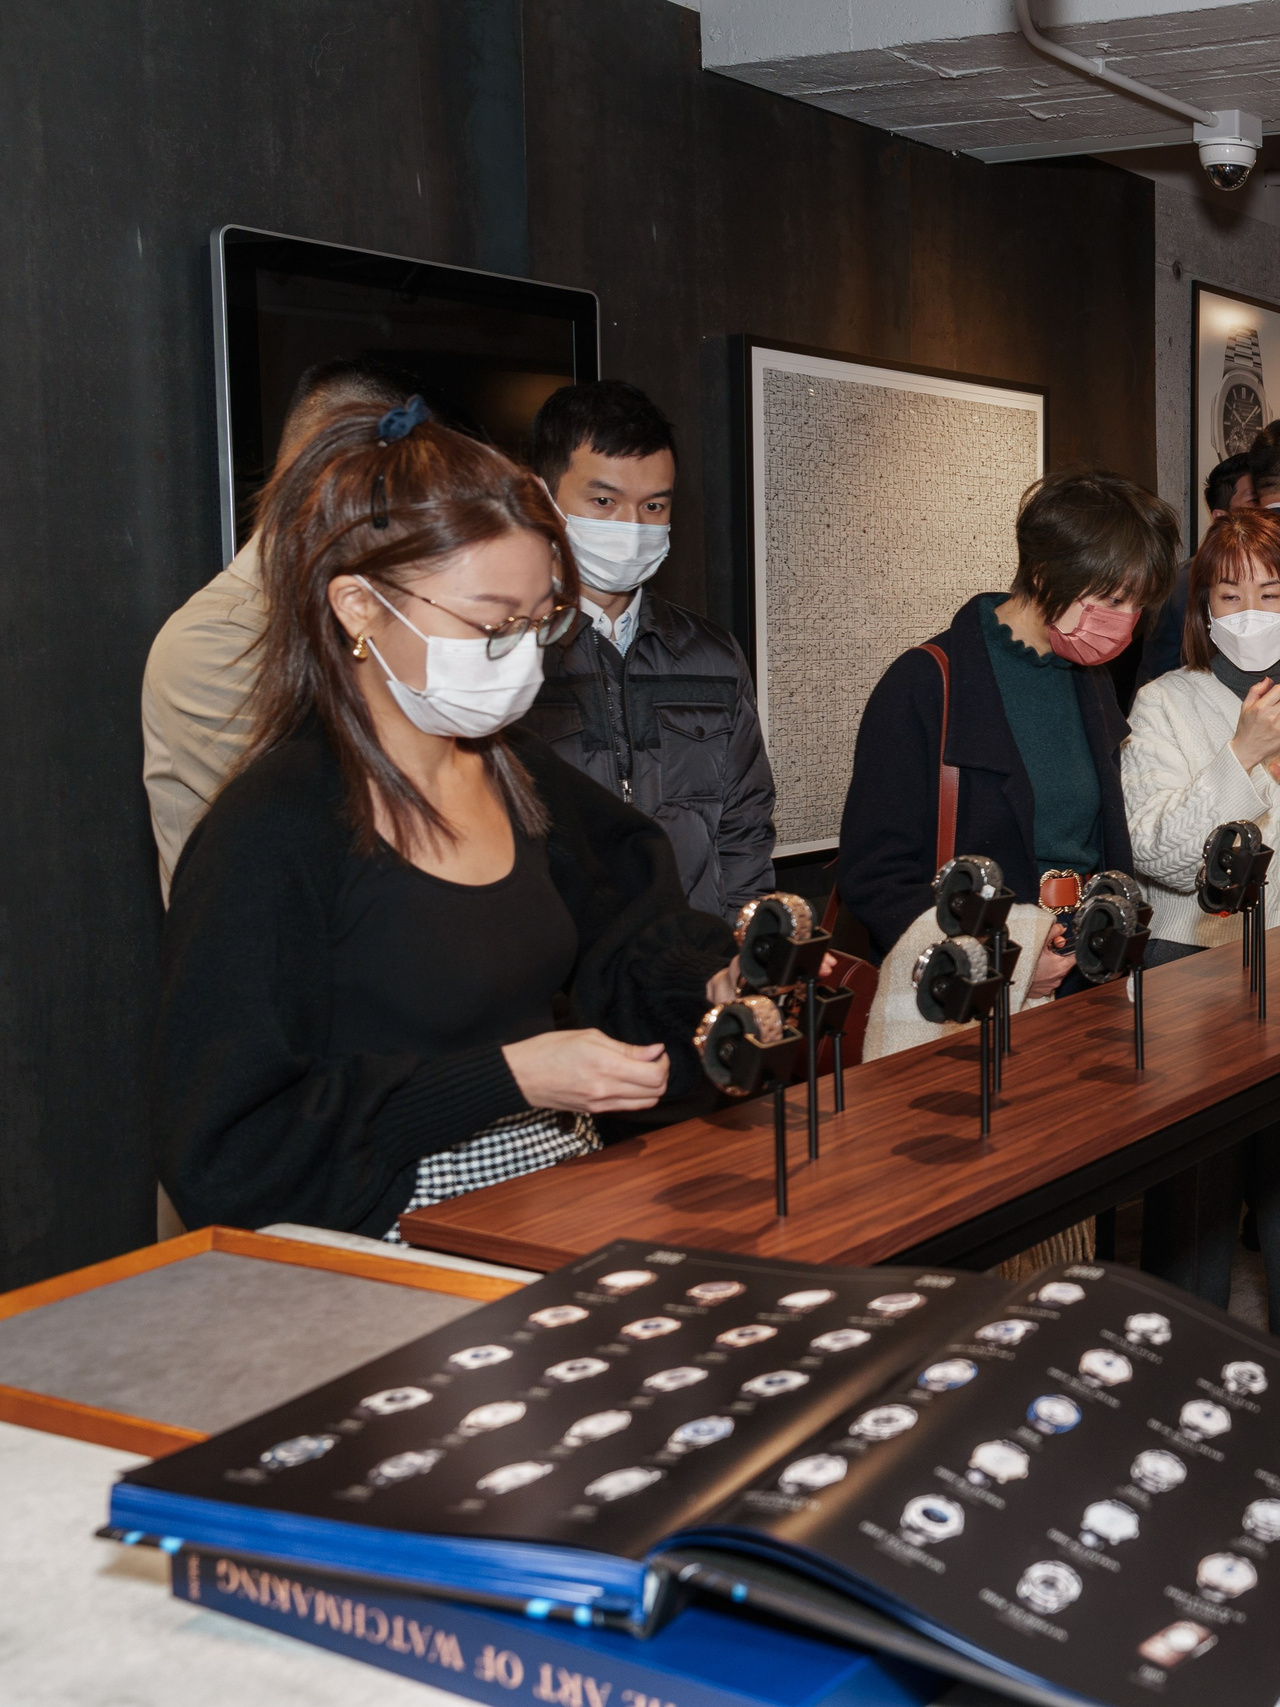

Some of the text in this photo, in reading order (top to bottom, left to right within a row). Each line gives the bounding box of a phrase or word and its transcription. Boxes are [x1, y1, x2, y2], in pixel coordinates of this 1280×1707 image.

[215, 1557, 466, 1672] WATCHMAKING
[475, 1644, 524, 1690] OF
[532, 1662, 613, 1707] ART
